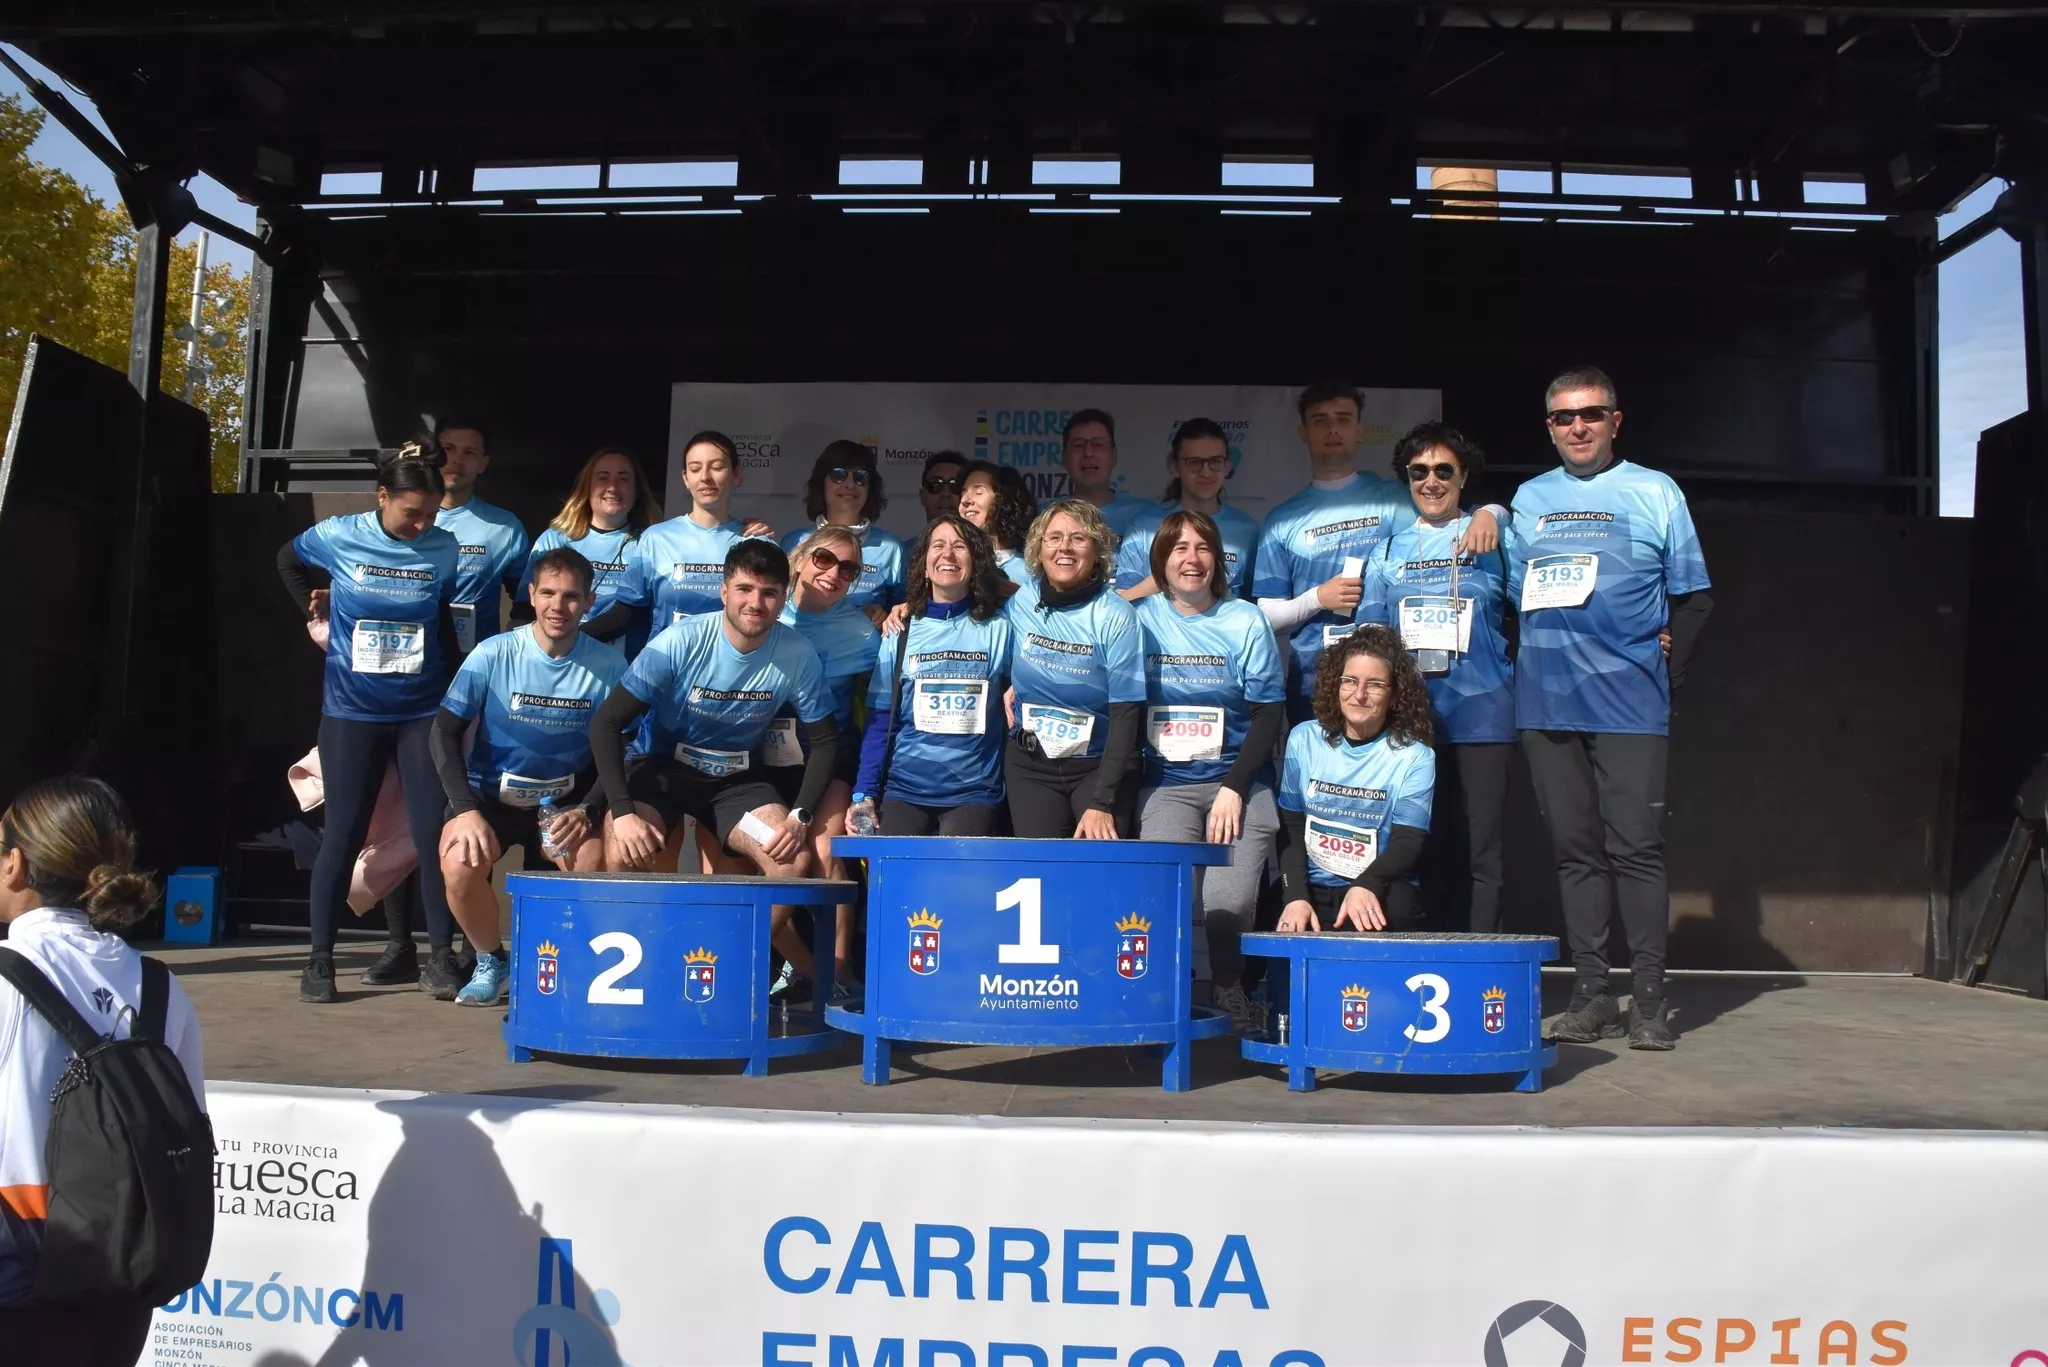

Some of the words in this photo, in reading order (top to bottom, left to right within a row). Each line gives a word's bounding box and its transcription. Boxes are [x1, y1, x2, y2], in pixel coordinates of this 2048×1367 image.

[1547, 512, 1613, 522] PROGRAMACIÓN
[1317, 517, 1379, 536] PROGRAMACIÓN
[1341, 541, 1356, 551] para
[1359, 537, 1381, 546] crecer
[367, 566, 434, 581] PROGRAMACIÓN
[686, 564, 724, 573] PROGRAM
[1537, 566, 1584, 583] 3193
[1428, 575, 1446, 583] para
[353, 584, 388, 596] software
[389, 588, 408, 597] para
[672, 583, 705, 591] software
[707, 584, 721, 592] par
[1412, 609, 1460, 625] 3205
[367, 633, 414, 649] 3197
[1034, 636, 1093, 655] PROGRAMACIÓN
[921, 651, 988, 662] PROGRAMACIÓN
[1159, 655, 1226, 665] PROGRAMACIÓN
[1048, 661, 1063, 671] para
[1065, 667, 1091, 676] crecer
[1199, 677, 1225, 685] crecer
[524, 696, 591, 709] PROGRAMACIÓN
[705, 690, 773, 701] PROGRAMACIÓN
[929, 695, 977, 711] 3192
[508, 713, 543, 725] software
[1033, 718, 1080, 740] 3198
[1162, 722, 1213, 737] 2090
[516, 789, 563, 800] 3200
[1319, 782, 1387, 800] PROGRAMACIÓN
[1305, 802, 1336, 815] software
[1338, 809, 1356, 818] para
[1358, 812, 1384, 821] crecer
[1319, 835, 1366, 858] 2092
[995, 878, 1060, 965] 1
[587, 931, 644, 1005] 2
[980, 973, 1079, 997] Monzón
[980, 997, 1079, 1012] Ayuntamiento
[1403, 973, 1451, 1043] 3
[762, 1216, 1270, 1311] CARRERA
[154, 1322, 224, 1336] ASOCIACIÓN
[154, 1335, 169, 1345] DE
[173, 1336, 253, 1352] EMPRESARIOS
[1622, 1317, 1909, 1367] ESPIAS
[154, 1348, 203, 1360] MONZÓN
